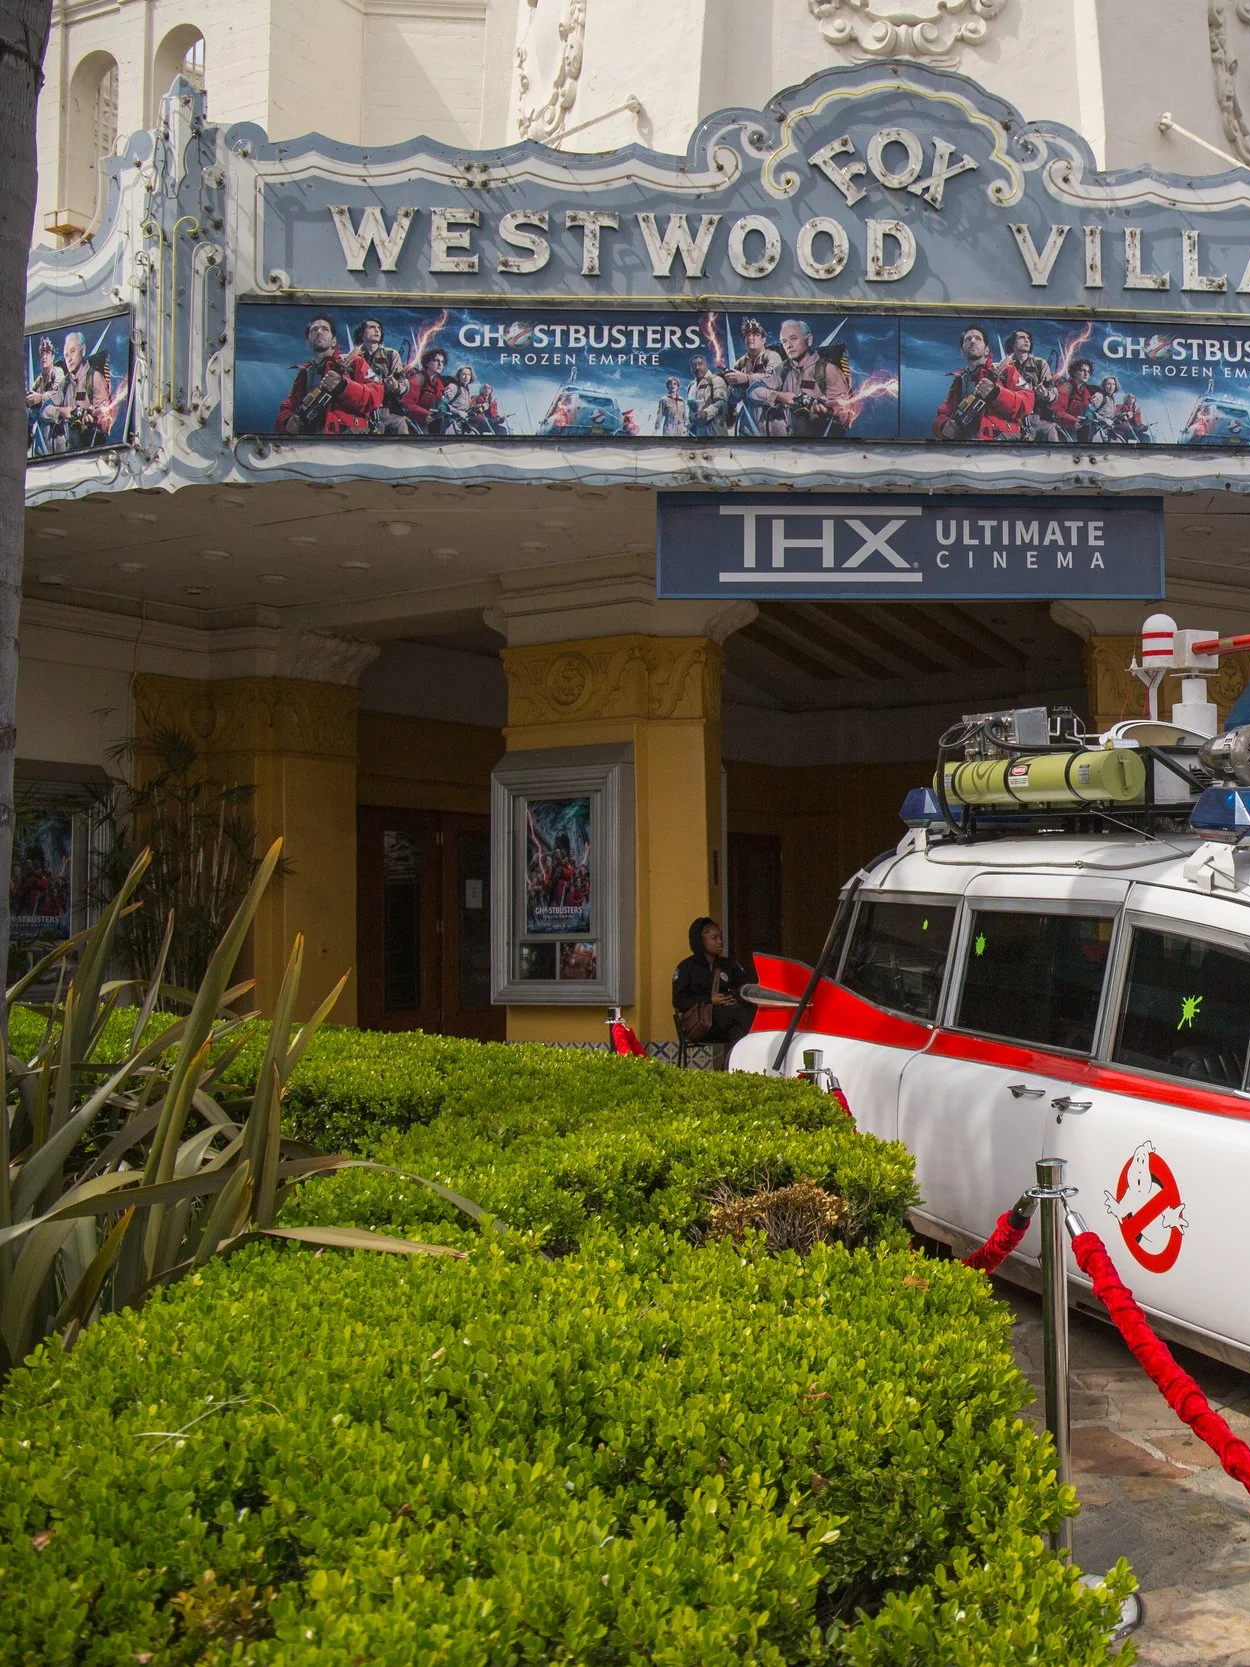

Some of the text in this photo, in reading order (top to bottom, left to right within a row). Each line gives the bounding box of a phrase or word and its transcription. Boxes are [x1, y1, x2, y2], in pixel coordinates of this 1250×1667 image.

[809, 128, 979, 210] FOX
[327, 204, 917, 283] WESTWOOD
[500, 353, 660, 366] FROZEN EMPIRE
[1142, 364, 1213, 377] FROZEN
[719, 505, 922, 569] THX
[935, 519, 1105, 547] ULTIMATE
[935, 550, 1105, 569] CINEMA
